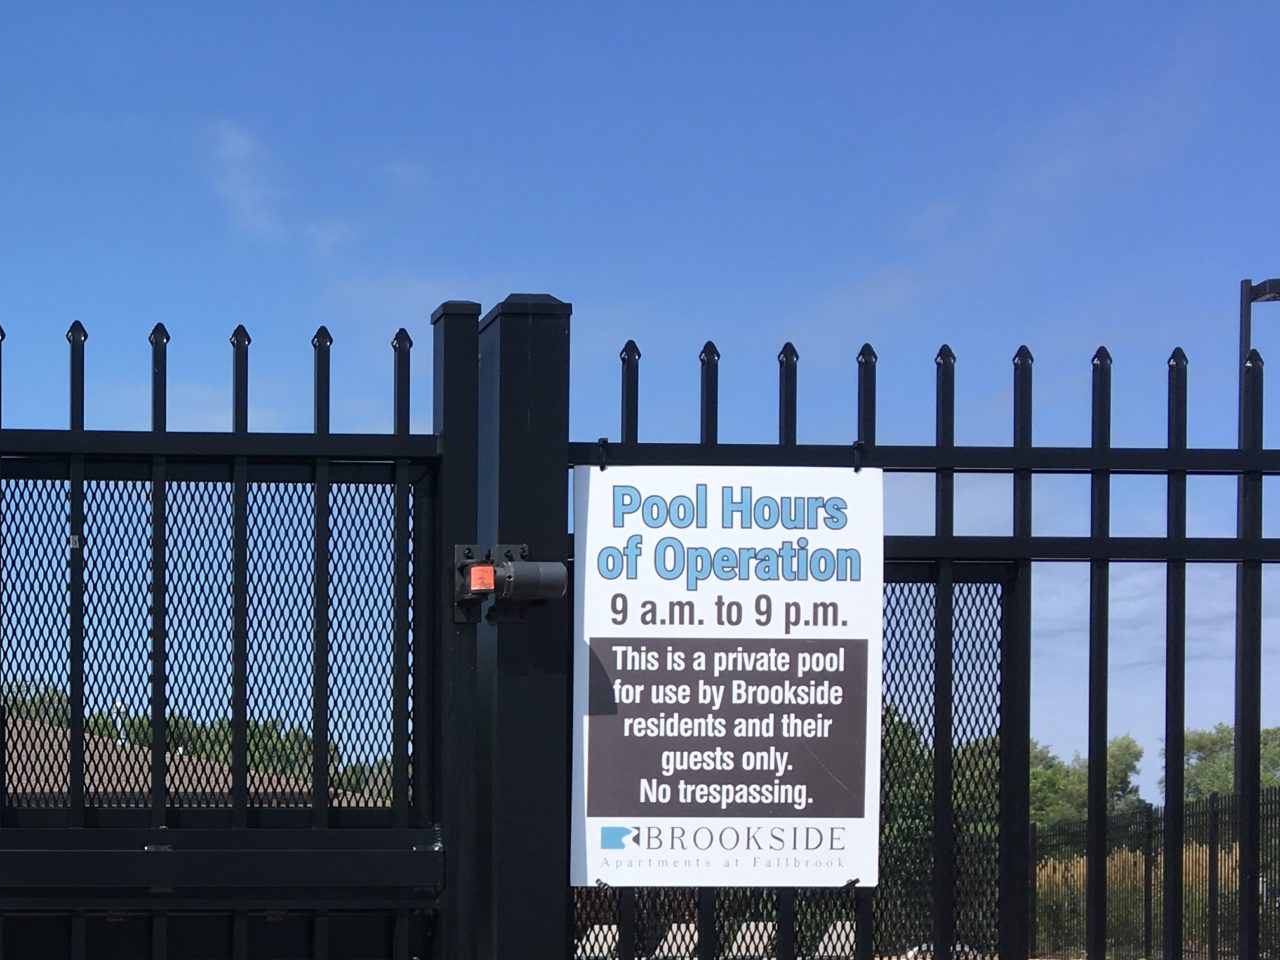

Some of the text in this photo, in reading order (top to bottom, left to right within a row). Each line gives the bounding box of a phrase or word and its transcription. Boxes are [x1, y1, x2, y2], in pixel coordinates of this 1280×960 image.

[612, 484, 848, 530] Pool Hours
[597, 534, 861, 591] of Operation
[610, 593, 848, 634] 9 a.m. to 9 p.m.
[612, 645, 845, 677] This is a private pool
[613, 679, 843, 710] for use by Brookside
[623, 713, 833, 738] residents and their
[661, 746, 793, 776] guests only.
[639, 778, 814, 810] No trespassing.
[646, 826, 846, 851] BROOKSIDE
[601, 856, 845, 869] Apartments at Fallbrook
